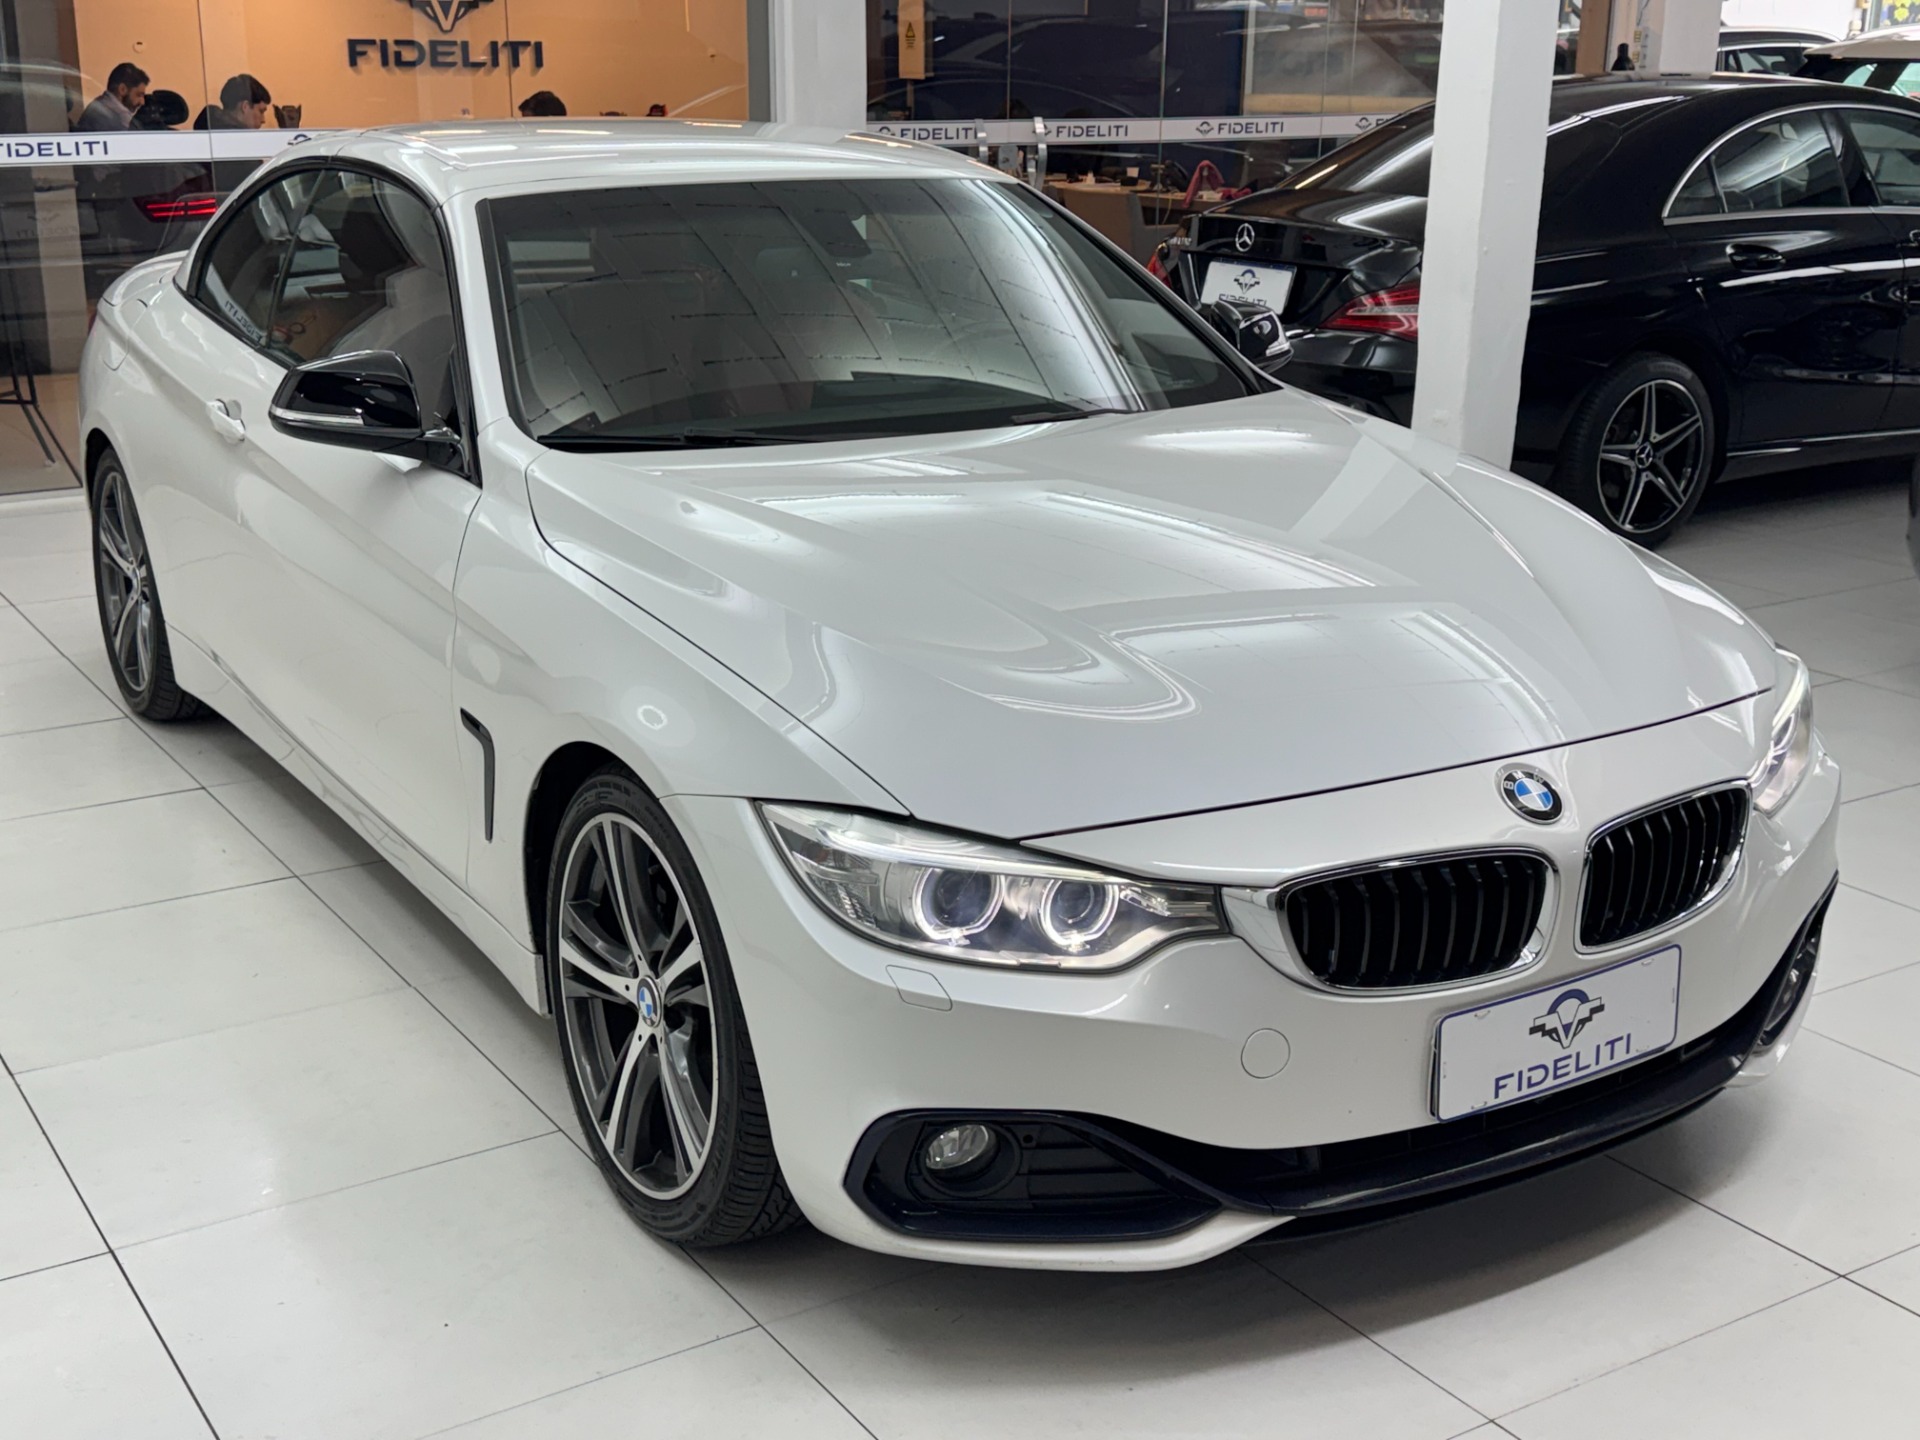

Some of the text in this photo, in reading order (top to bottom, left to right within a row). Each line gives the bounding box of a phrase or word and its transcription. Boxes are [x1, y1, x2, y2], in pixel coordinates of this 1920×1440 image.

[347, 38, 544, 68] FIDELITI
[900, 127, 979, 141] FIDELITI
[1055, 124, 1128, 138] FIDELITI
[1217, 121, 1284, 134] FIDELITI
[1503, 769, 1546, 790] BMW
[1494, 1032, 1631, 1100] FIDELITI
